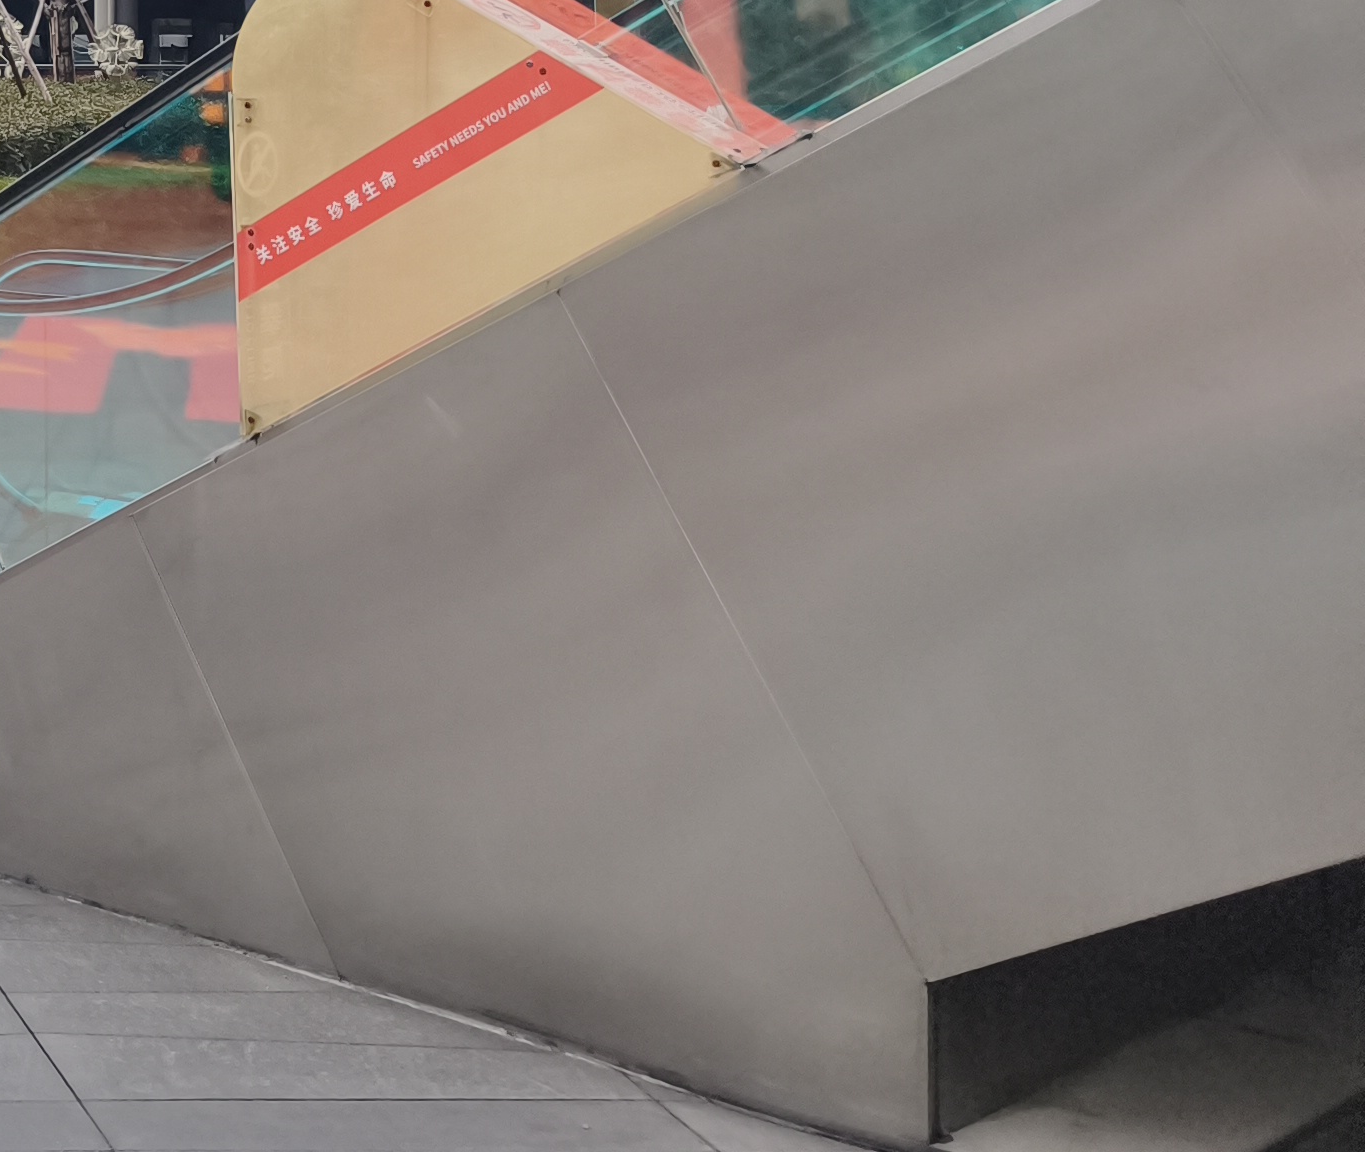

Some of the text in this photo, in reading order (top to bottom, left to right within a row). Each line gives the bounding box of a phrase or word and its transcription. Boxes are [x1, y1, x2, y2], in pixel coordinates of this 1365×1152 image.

[412, 80, 552, 169] SAFETY NEEDS YOU AND ME!
[256, 170, 397, 265] 关注安全 珍爱生命
